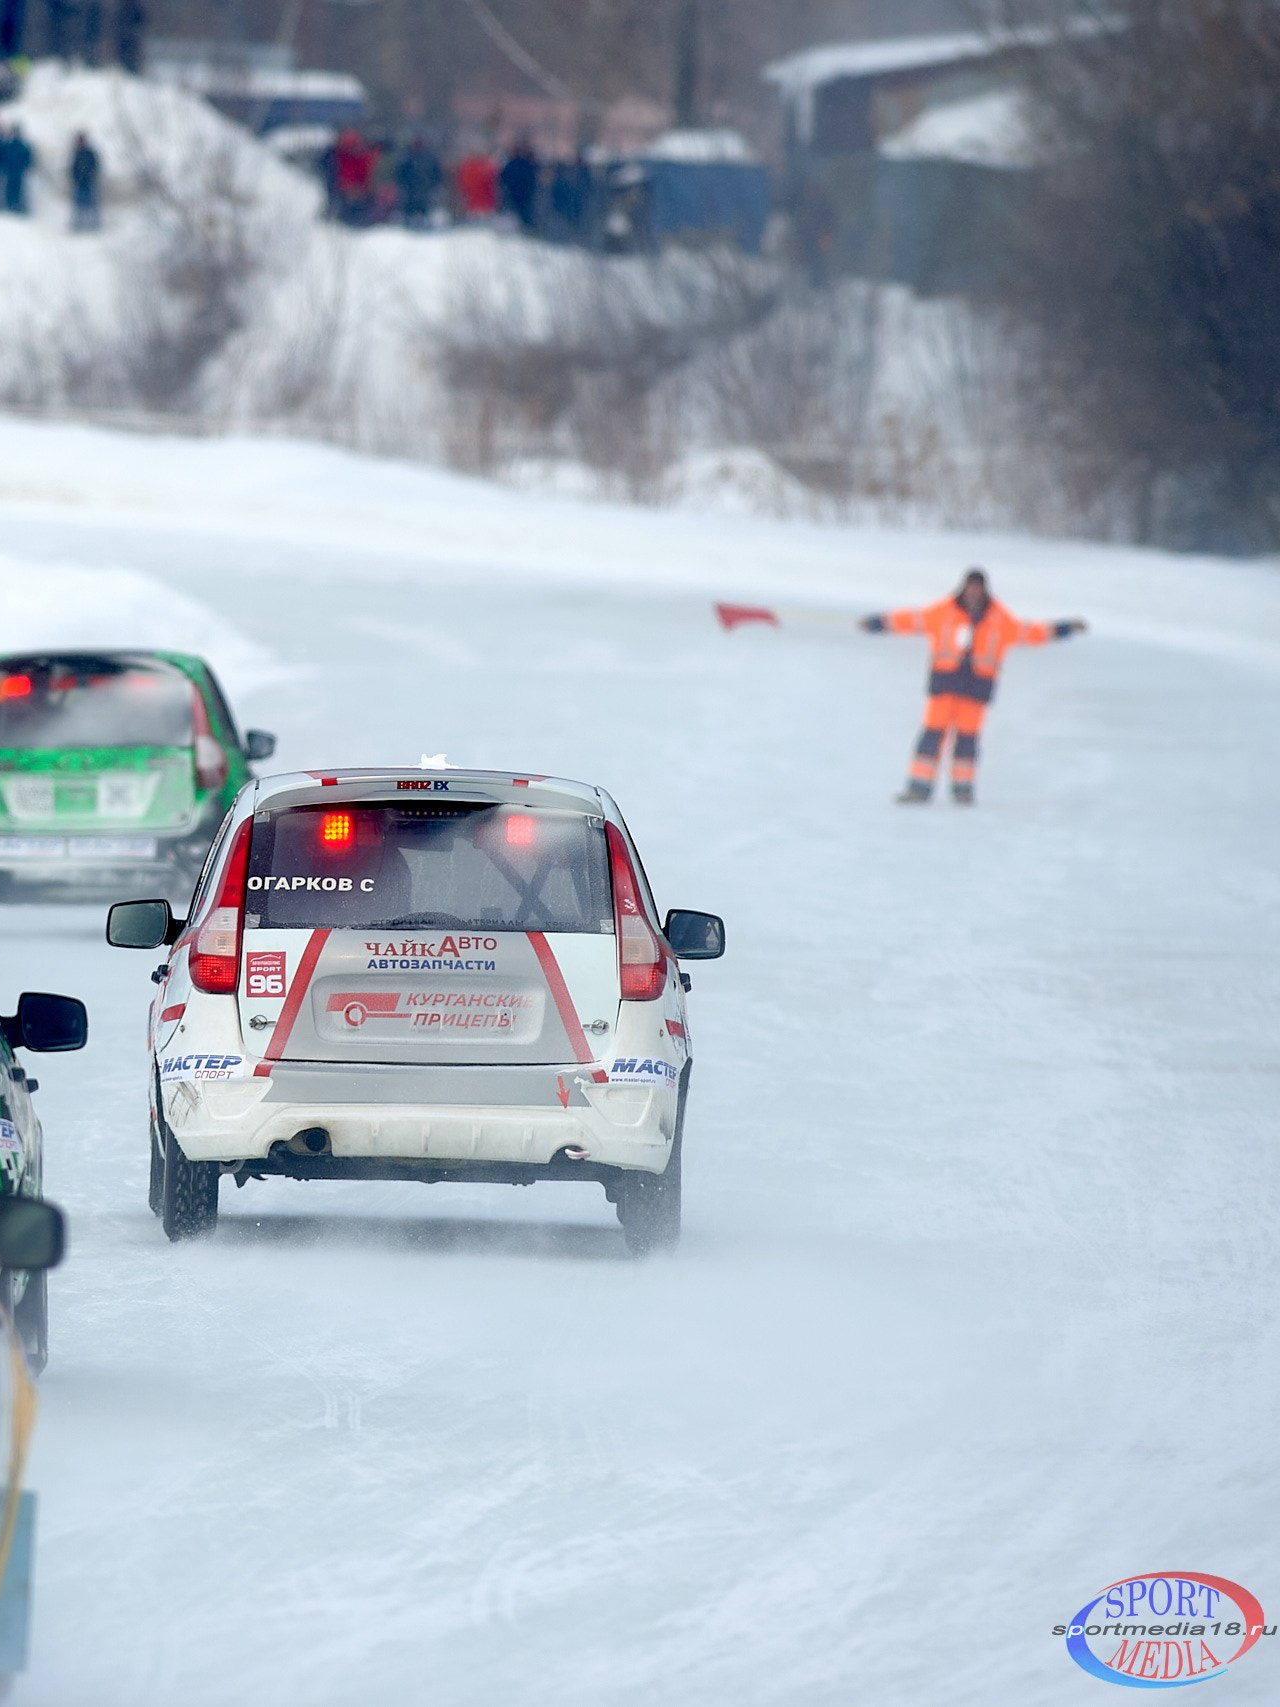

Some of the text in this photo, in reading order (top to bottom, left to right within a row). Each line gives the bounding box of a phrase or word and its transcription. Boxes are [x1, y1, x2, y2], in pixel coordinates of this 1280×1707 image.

[247, 876, 375, 892] ОГАРКОВ С
[367, 959, 496, 971] АВТОЗАПЧАСТИ
[249, 974, 283, 994] 96
[406, 992, 535, 1008] КУРГАНСКИЕ
[413, 1012, 517, 1028] ПРИЦЕПЫ
[162, 1054, 243, 1074] МАСТЕР
[194, 1070, 234, 1079] СПОРТ
